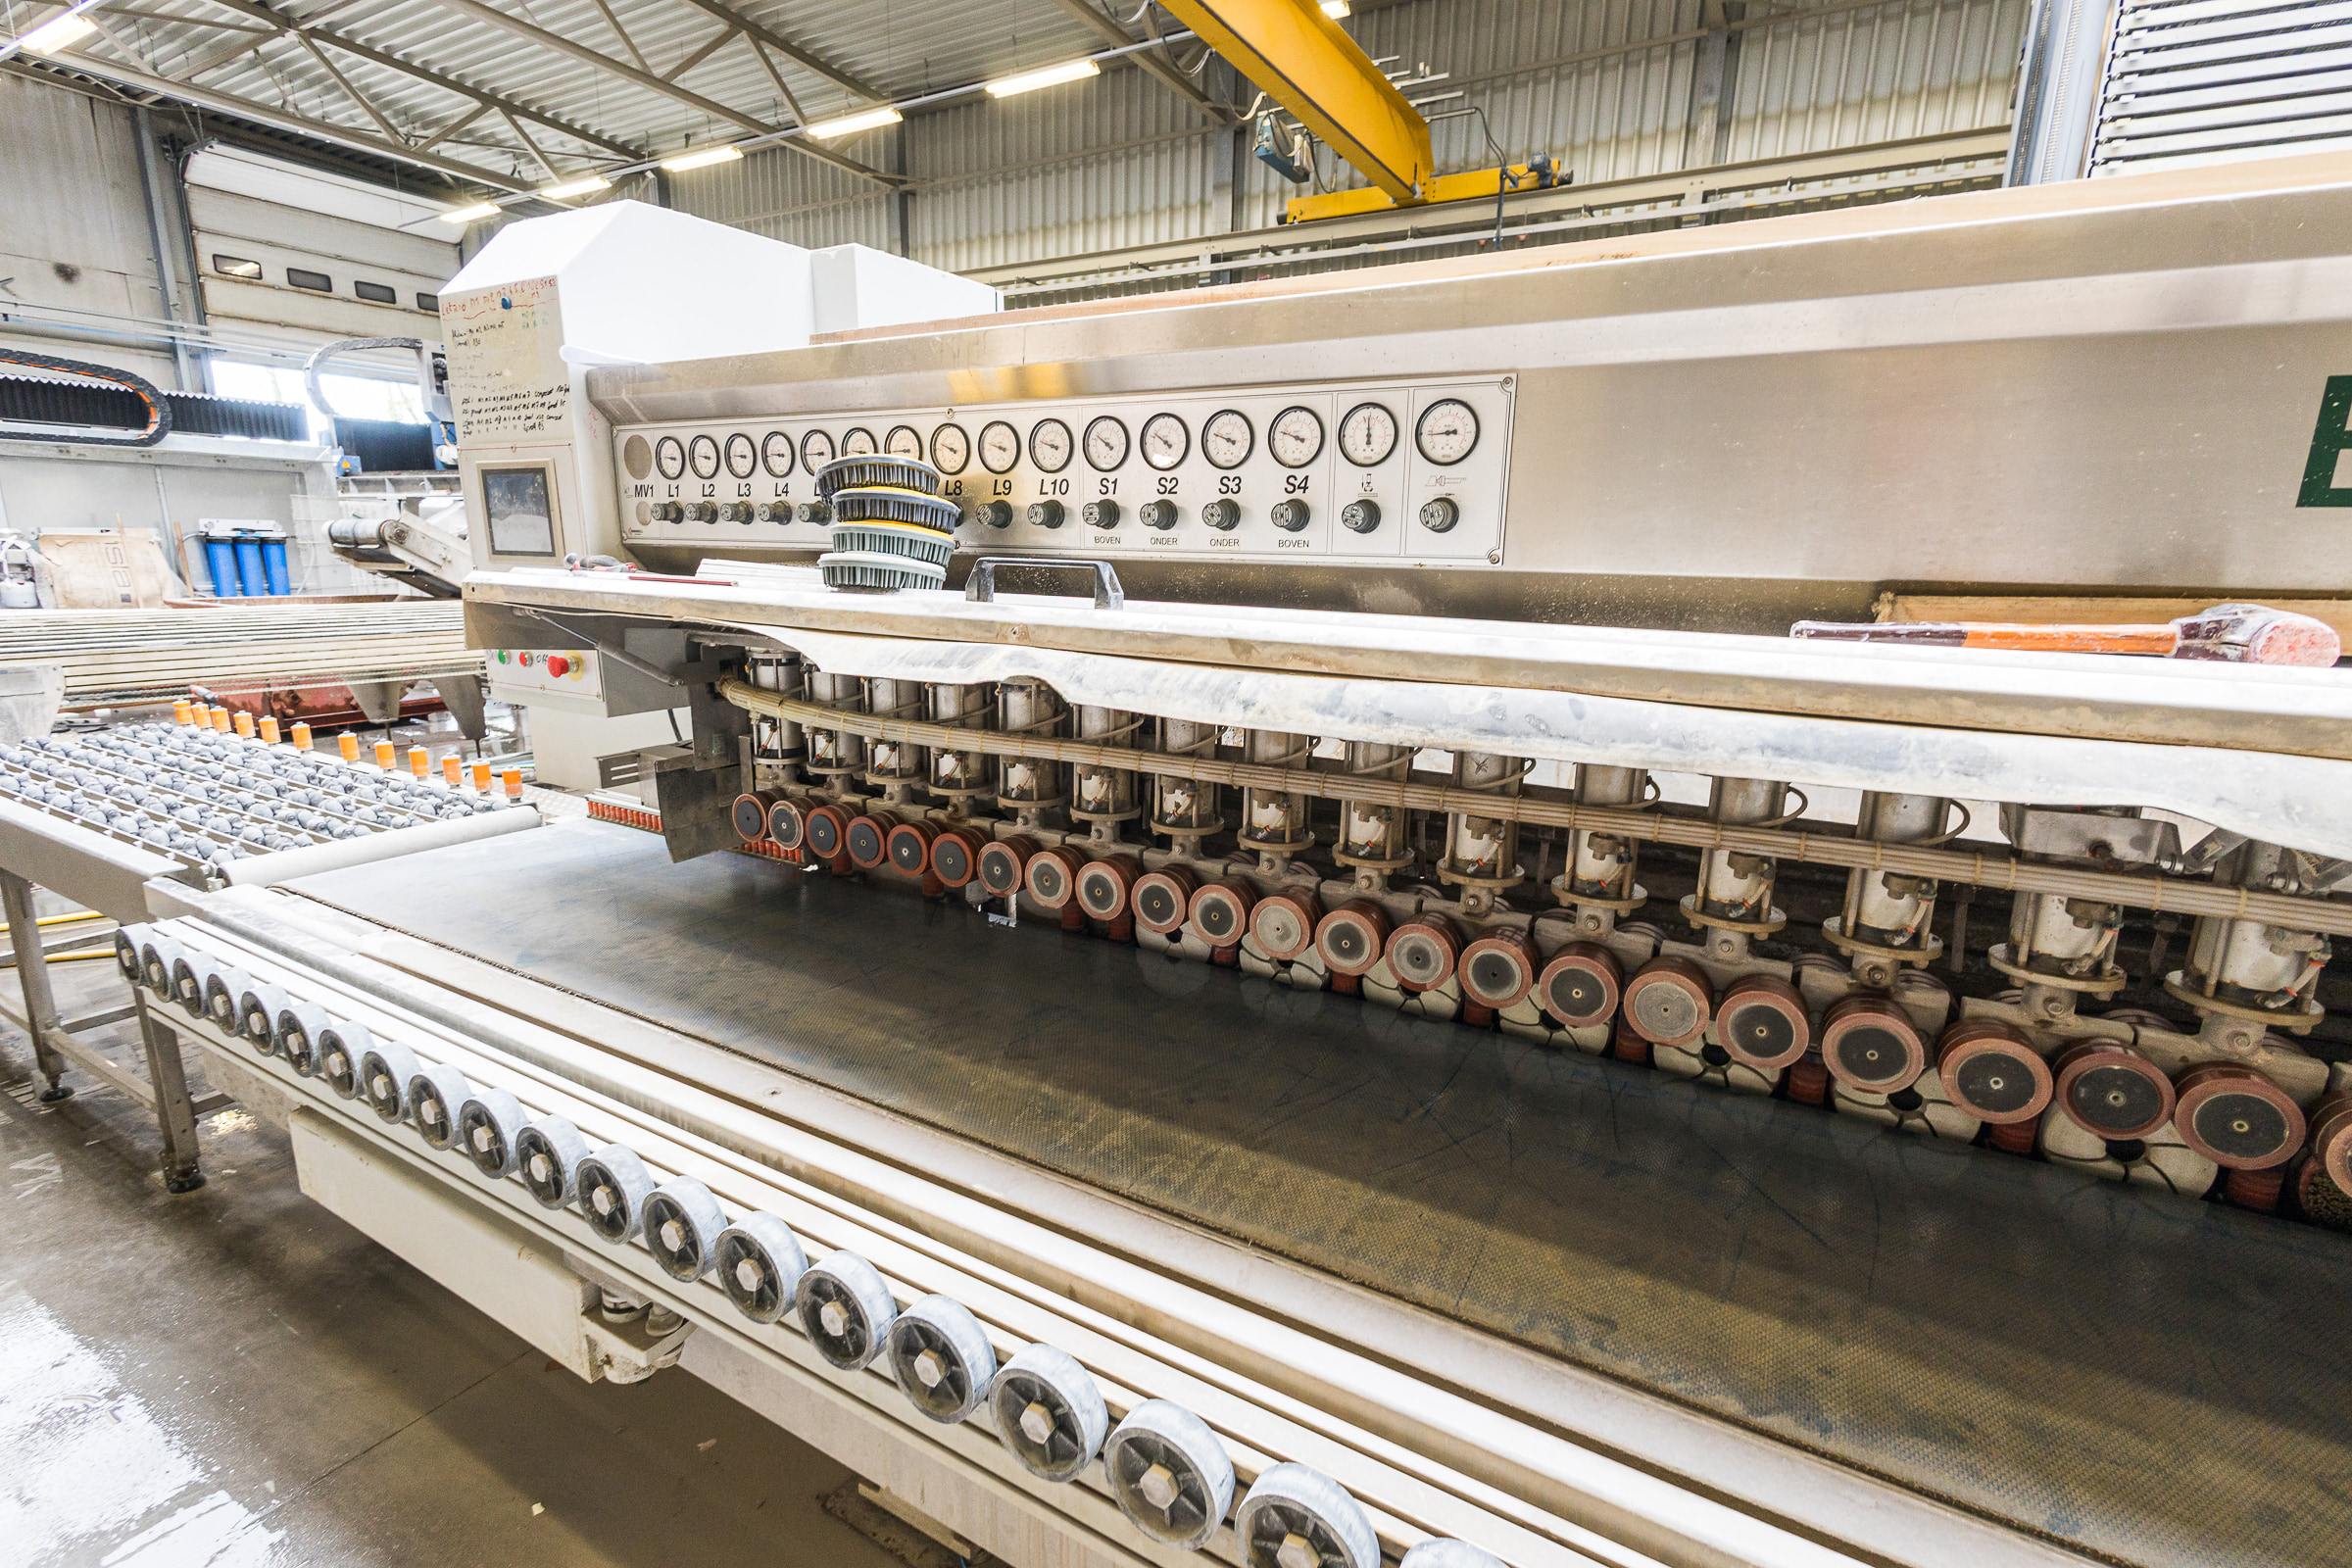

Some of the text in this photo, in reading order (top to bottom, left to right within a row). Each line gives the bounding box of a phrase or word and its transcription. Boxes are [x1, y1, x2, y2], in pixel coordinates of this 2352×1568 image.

[634, 483, 654, 498] MV1
[667, 483, 680, 498] L1
[702, 483, 715, 498] L2
[737, 482, 752, 498] L3
[774, 482, 790, 498] L4
[944, 479, 963, 496] L8
[993, 478, 1012, 496] L9
[1039, 478, 1070, 496] L10
[1099, 477, 1118, 496] S1
[1156, 476, 1179, 495] S2
[1218, 475, 1242, 495] S3
[1284, 474, 1309, 495] S4
[1094, 535, 1121, 544] BOVEN
[1150, 536, 1178, 546] ONDER
[1209, 538, 1240, 547] ONDER
[1278, 539, 1309, 548] BOVEN
